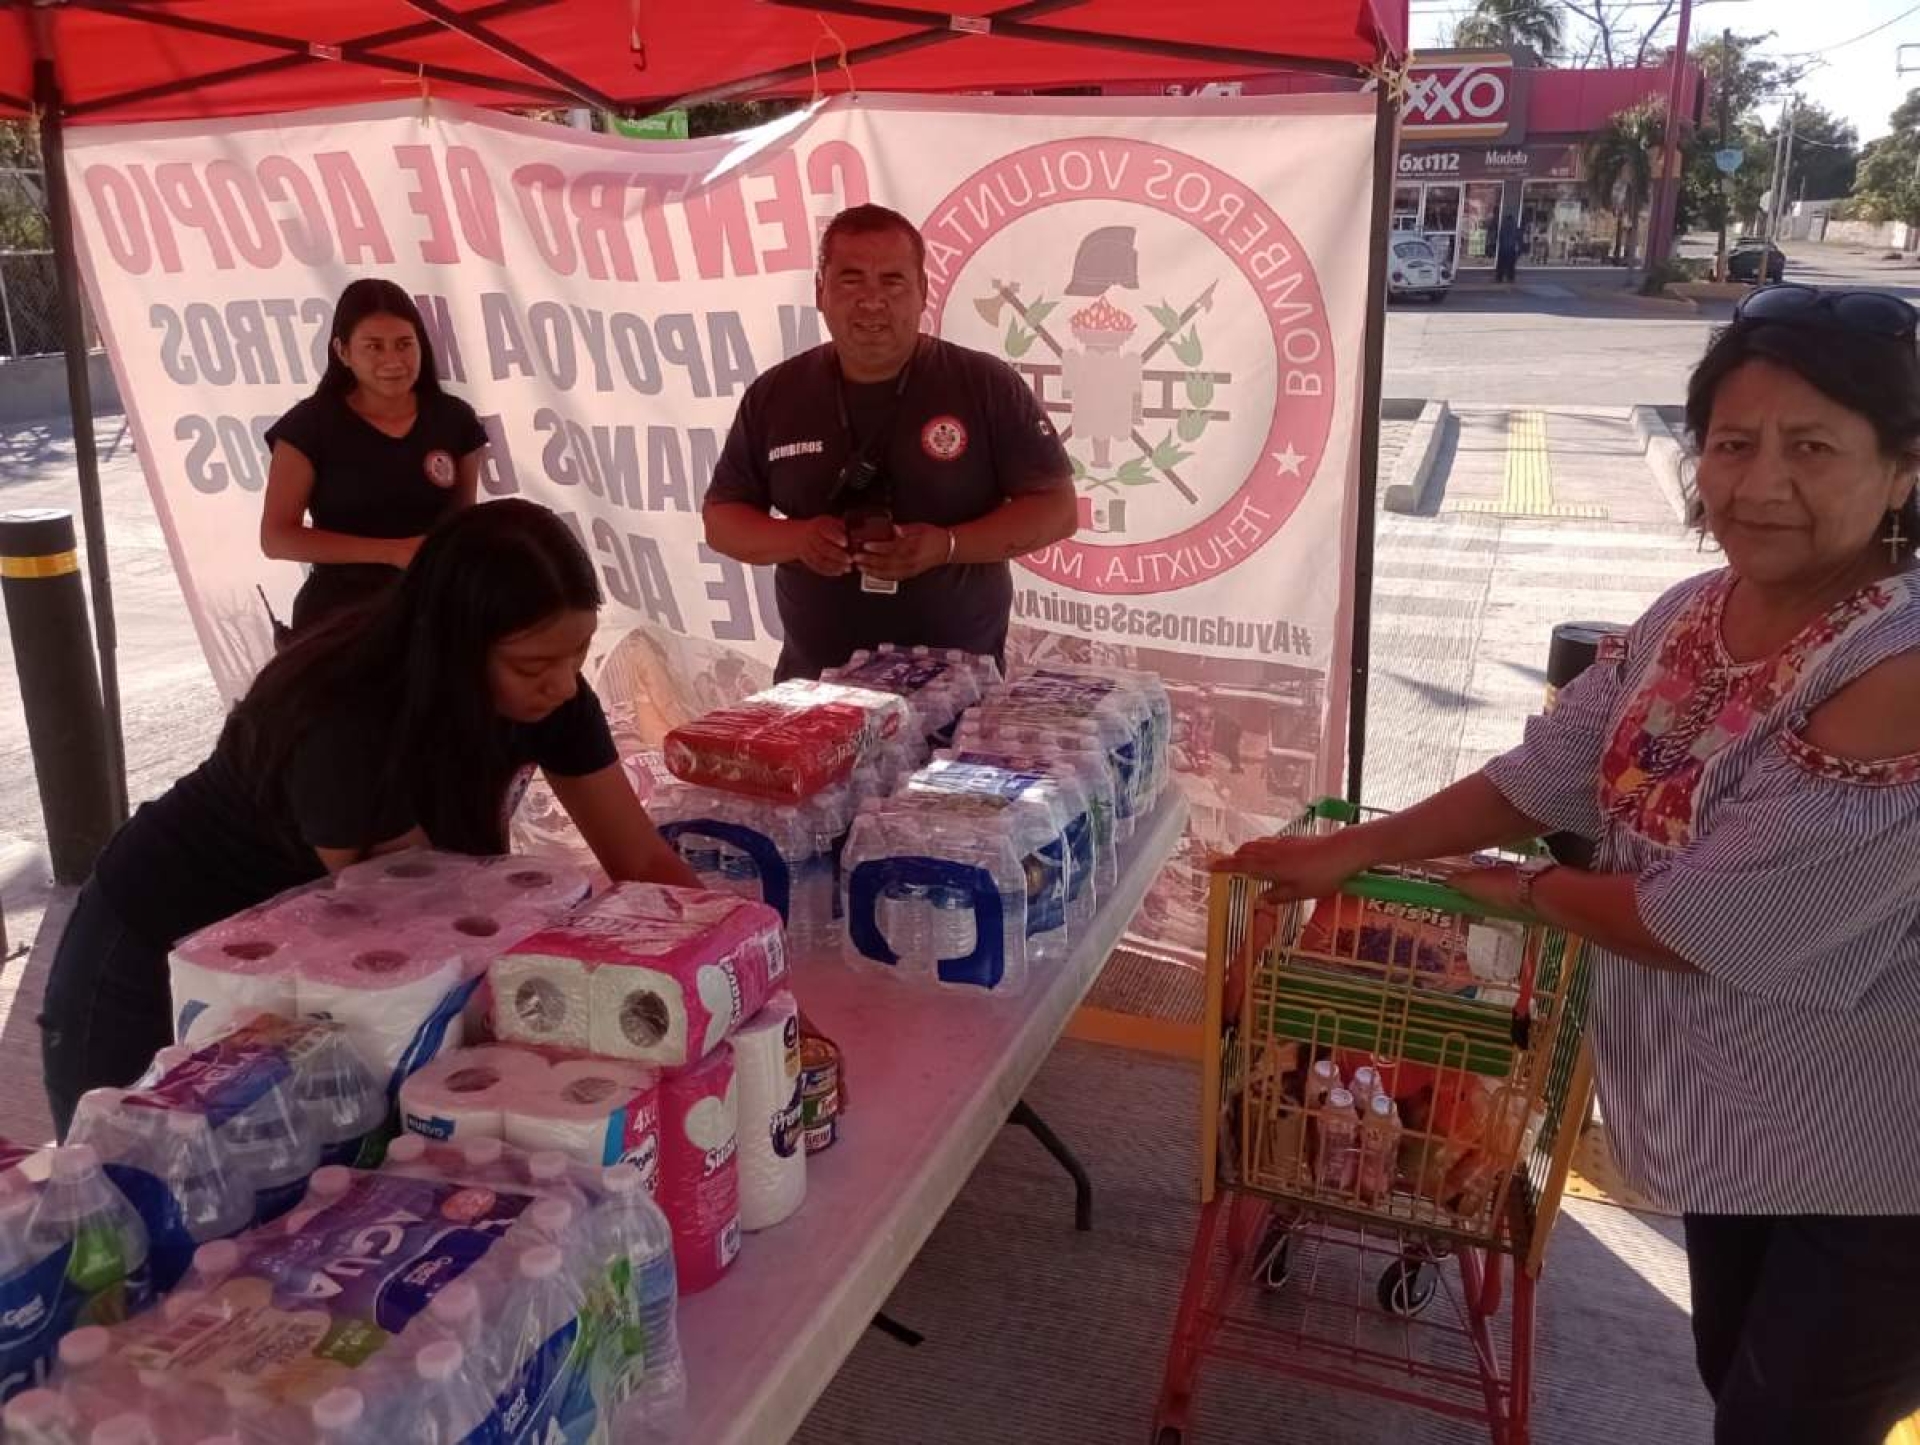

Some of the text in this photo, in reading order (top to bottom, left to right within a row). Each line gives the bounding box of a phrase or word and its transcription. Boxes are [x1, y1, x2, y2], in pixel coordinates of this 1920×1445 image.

[1368, 65, 1505, 120] XXO
[768, 440, 823, 462] BOMBEROS
[408, 1115, 446, 1137] NUEVO
